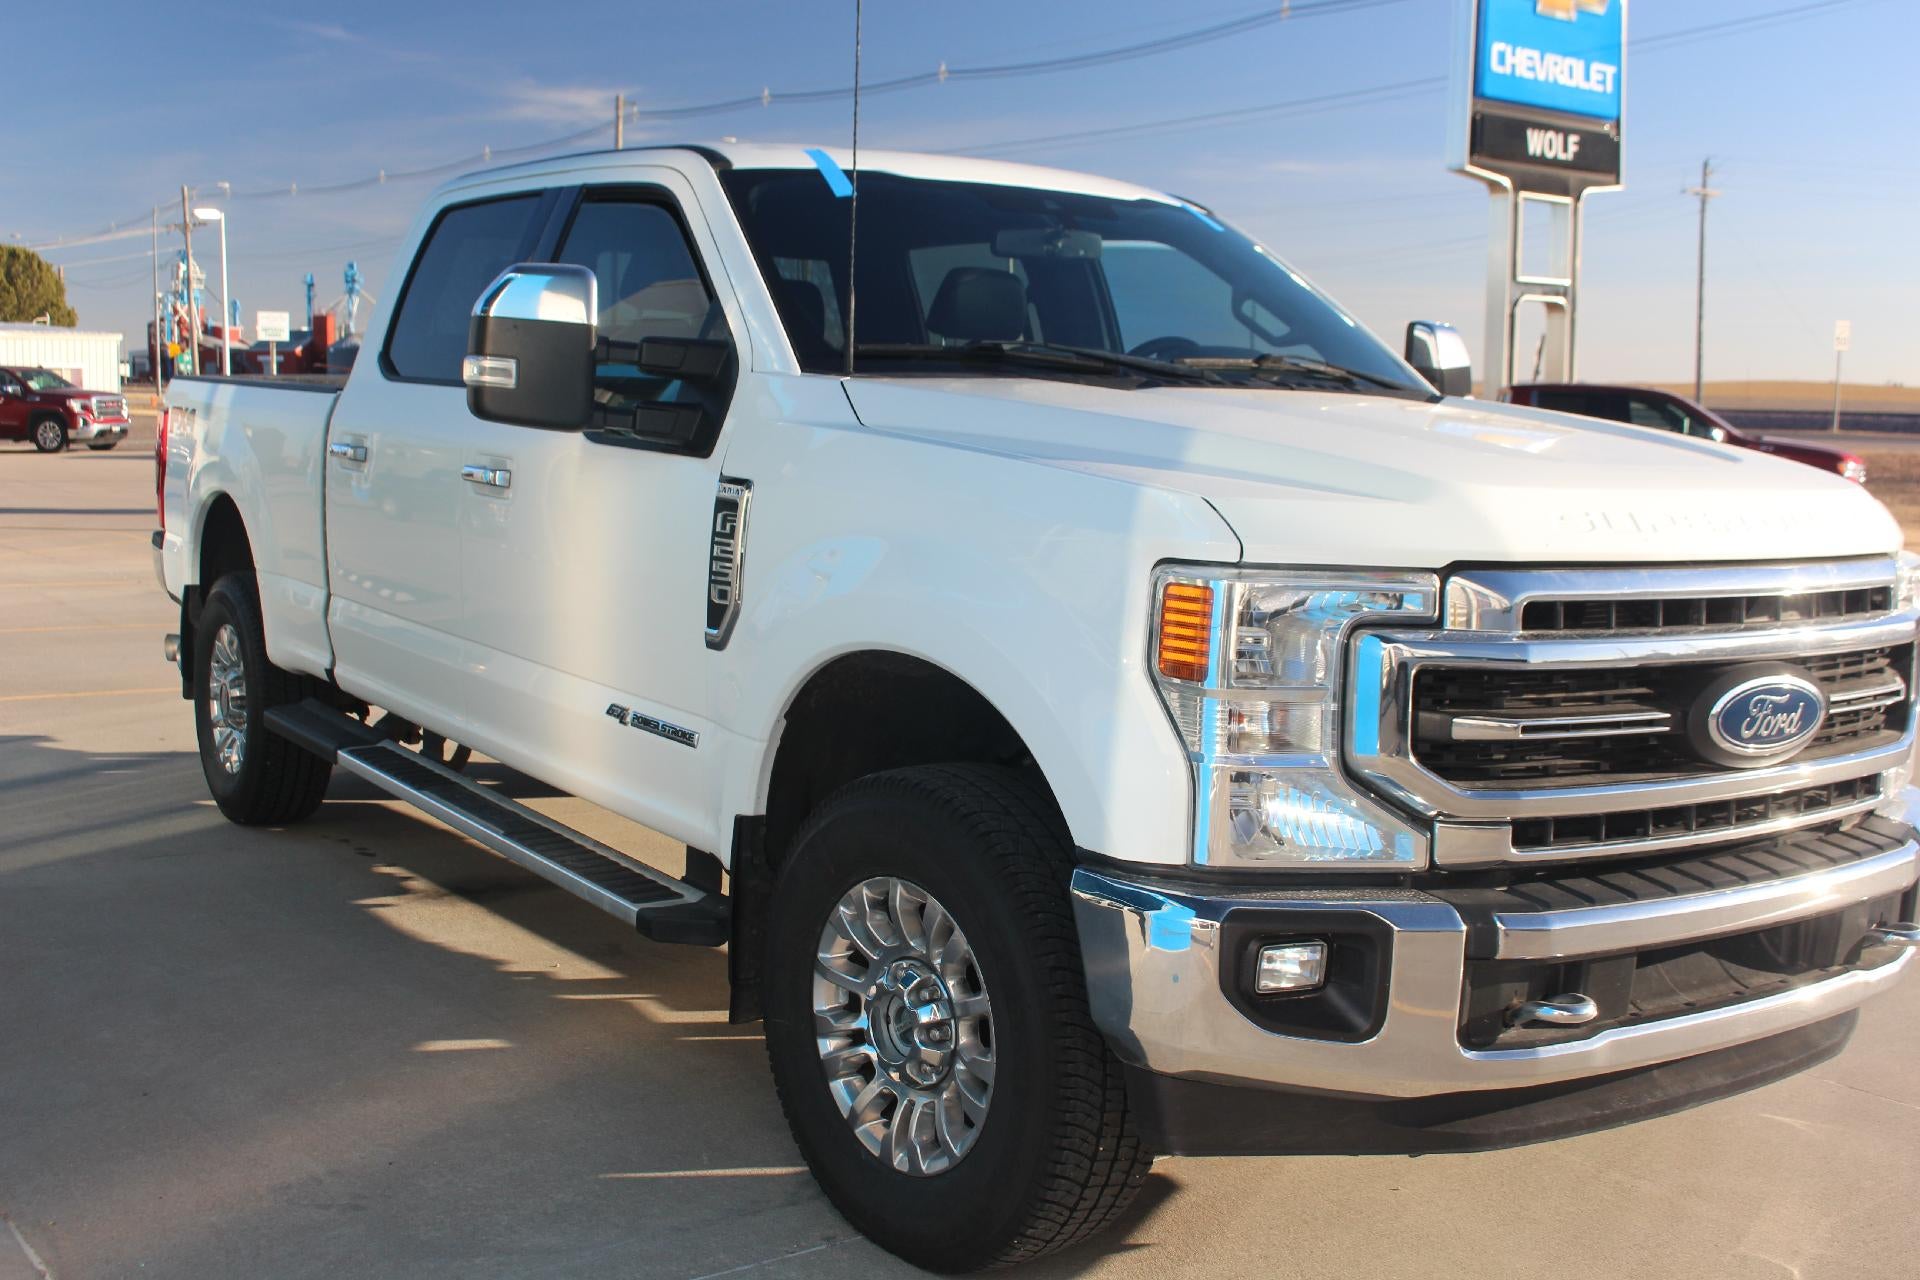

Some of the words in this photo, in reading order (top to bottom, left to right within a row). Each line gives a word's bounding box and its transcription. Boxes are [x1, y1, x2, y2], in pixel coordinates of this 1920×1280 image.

[1491, 41, 1617, 94] CHEVROLET
[1526, 127, 1580, 161] WOLF
[631, 713, 661, 731] POWER
[660, 723, 695, 743] STROKE
[1741, 693, 1805, 739] Ford
